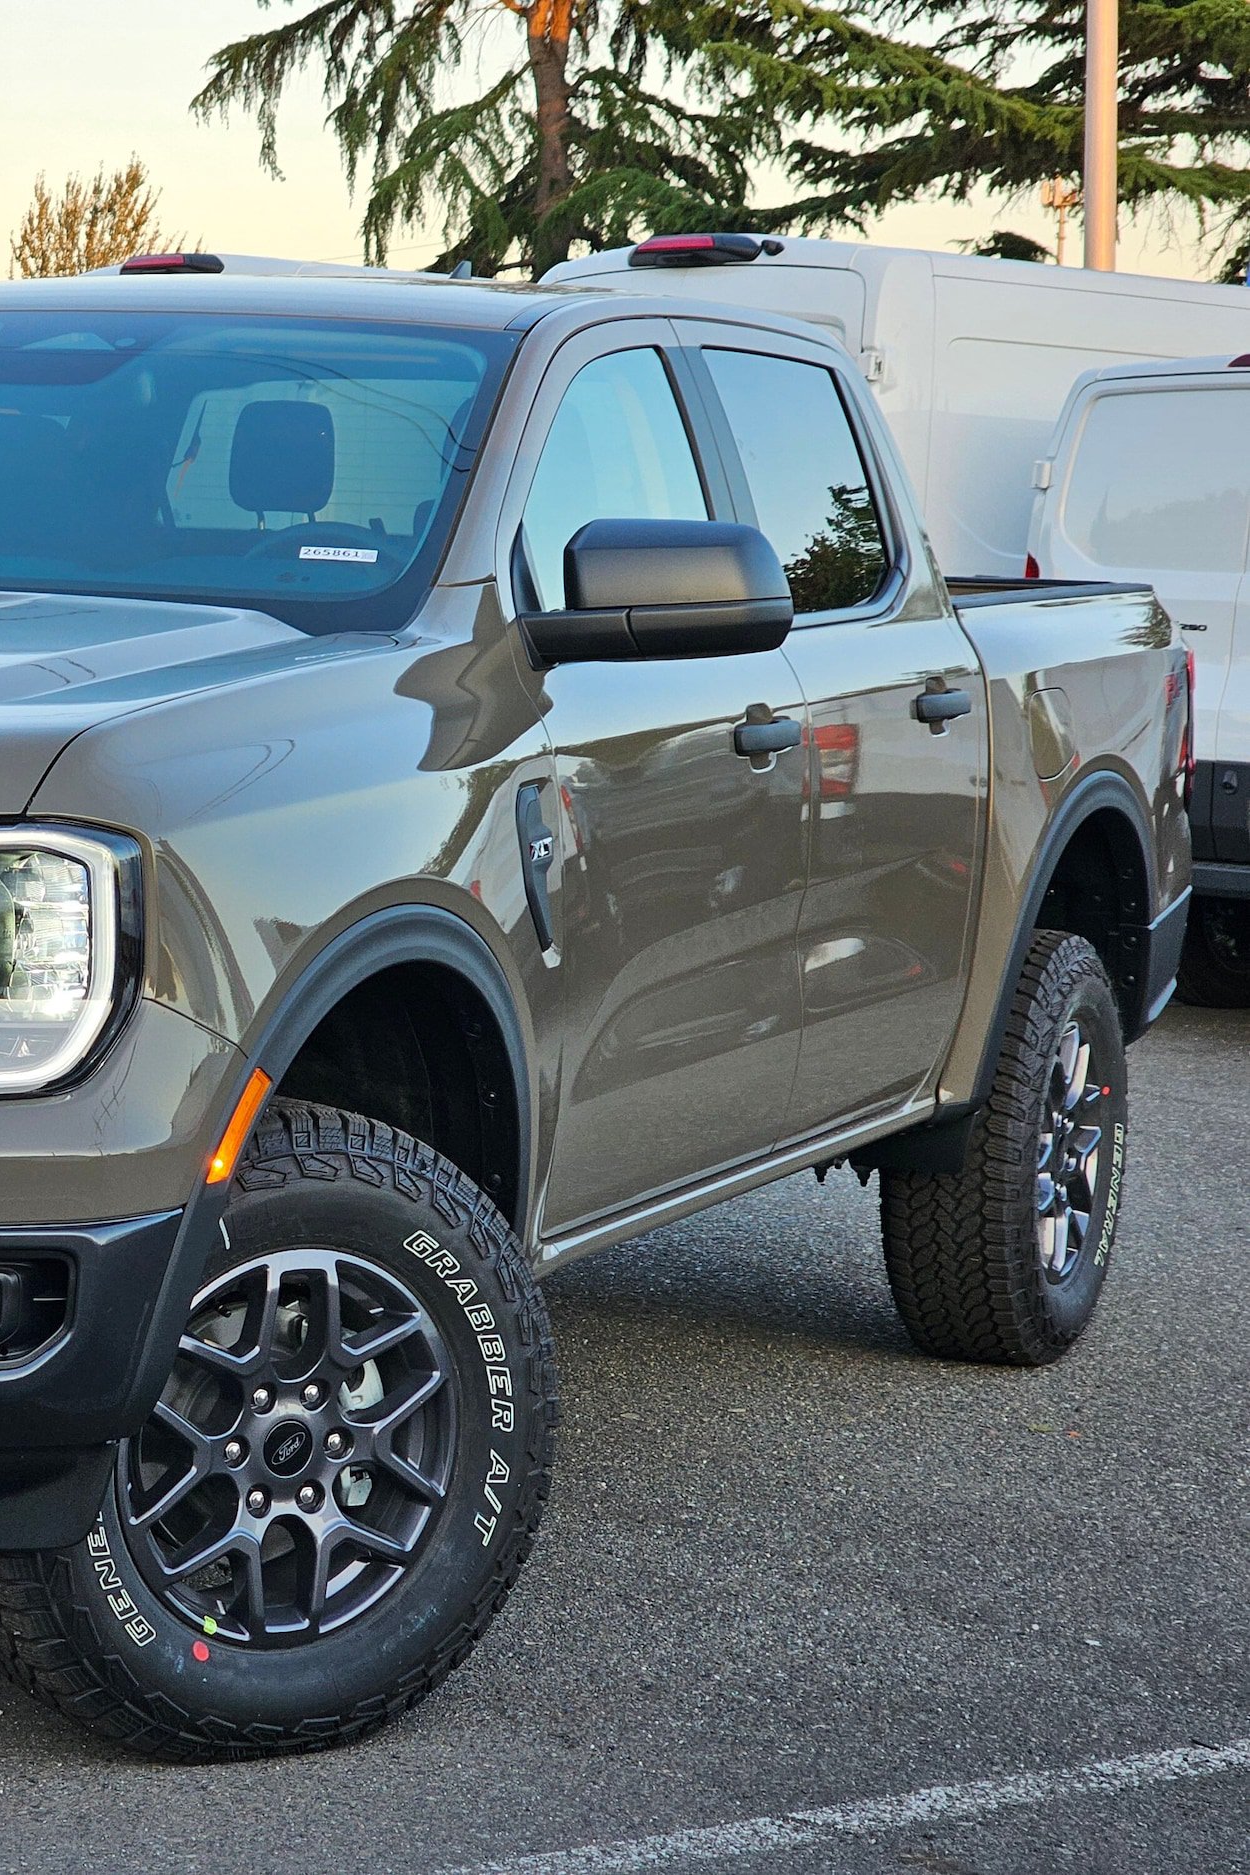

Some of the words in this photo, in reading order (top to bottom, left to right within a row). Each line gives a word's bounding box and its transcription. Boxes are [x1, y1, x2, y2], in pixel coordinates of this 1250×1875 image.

[302, 547, 361, 559] 265861
[1094, 1123, 1124, 1267] GENERAL
[278, 1436, 300, 1461] Ford
[403, 1230, 514, 1433] GRABBER
[473, 1448, 510, 1547] A/T
[87, 1510, 157, 1647] GENE
